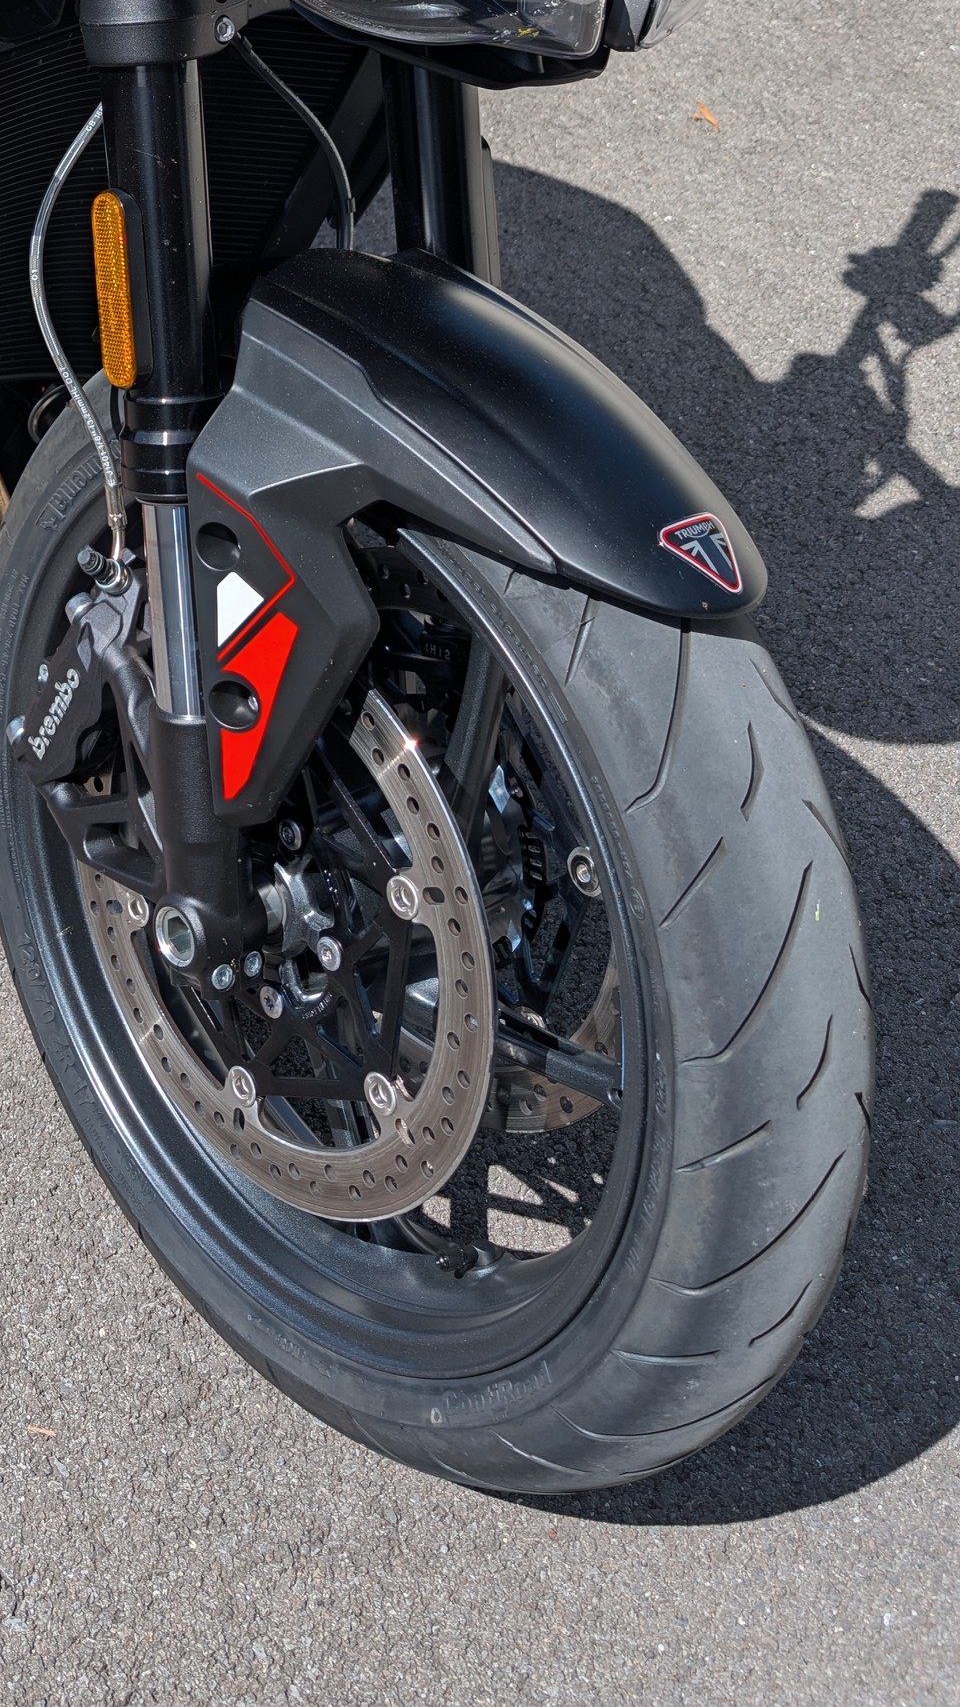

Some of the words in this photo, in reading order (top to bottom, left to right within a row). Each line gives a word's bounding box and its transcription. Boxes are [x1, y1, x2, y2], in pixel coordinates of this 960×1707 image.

[85, 119, 96, 132] GB
[674, 520, 716, 540] TRIUMPH
[27, 668, 80, 760] brembo
[20, 931, 57, 1025] 120/70
[73, 1079, 97, 1107] 17
[444, 1360, 553, 1417] ContiRoad
